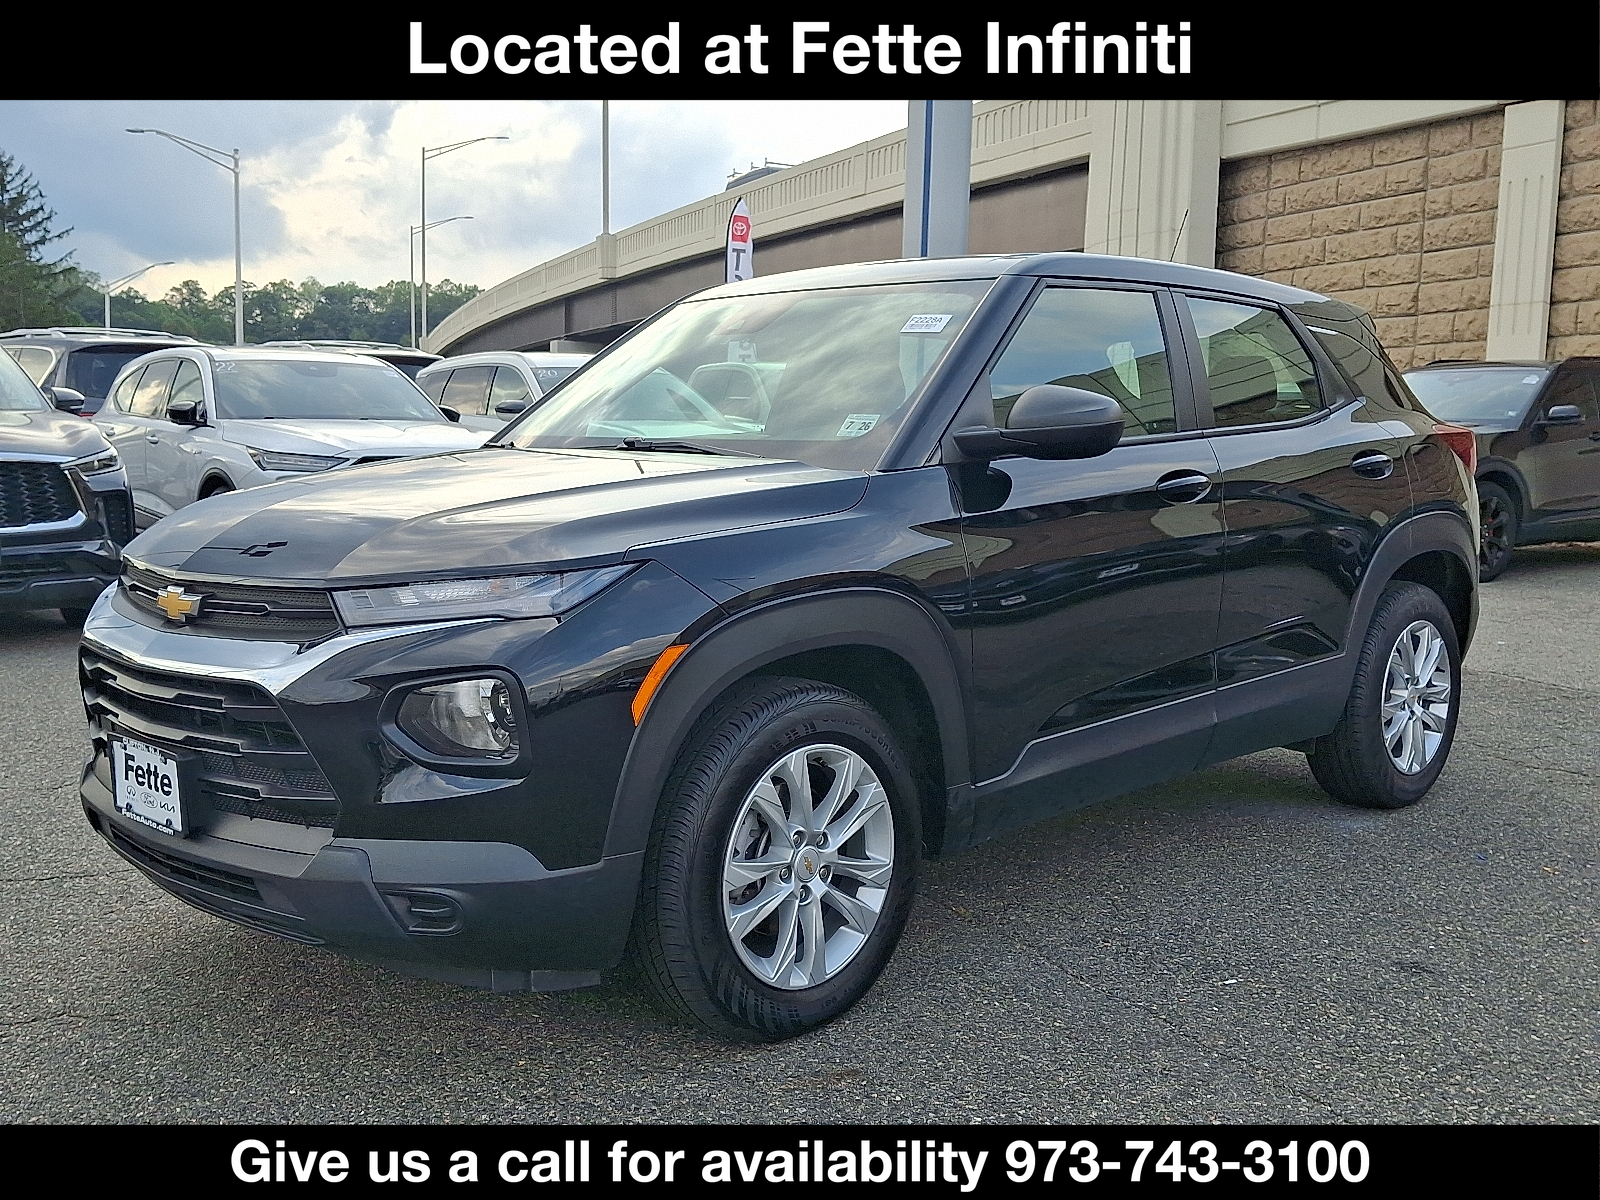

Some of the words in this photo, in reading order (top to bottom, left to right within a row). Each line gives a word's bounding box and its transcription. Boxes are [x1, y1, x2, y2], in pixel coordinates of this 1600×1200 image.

[845, 421, 855, 430] 7
[858, 421, 872, 431] 26
[124, 752, 173, 796] Fette
[121, 808, 174, 836] FetteAuto.com
